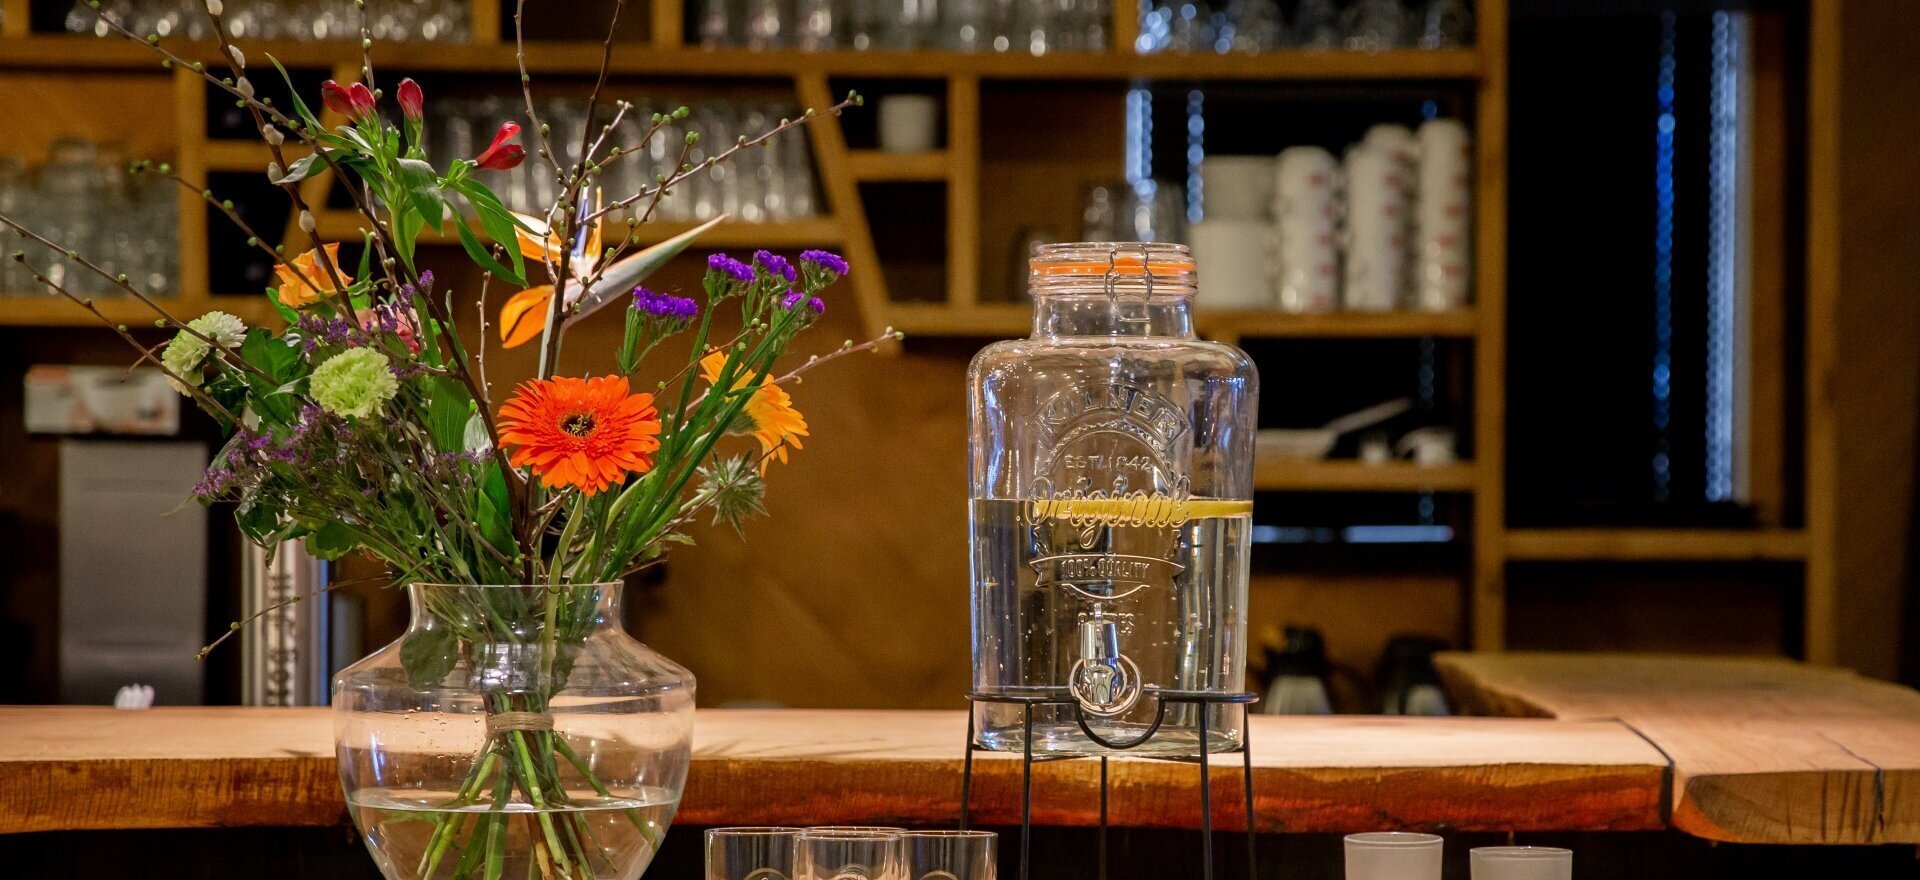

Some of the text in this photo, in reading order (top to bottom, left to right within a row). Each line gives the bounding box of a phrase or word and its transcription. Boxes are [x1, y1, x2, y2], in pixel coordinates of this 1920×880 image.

[1035, 384, 1184, 443] KILNER
[1108, 455, 1151, 470] 1842
[1025, 476, 1191, 549] Original
[1061, 558, 1150, 579] 100% QUALITY
